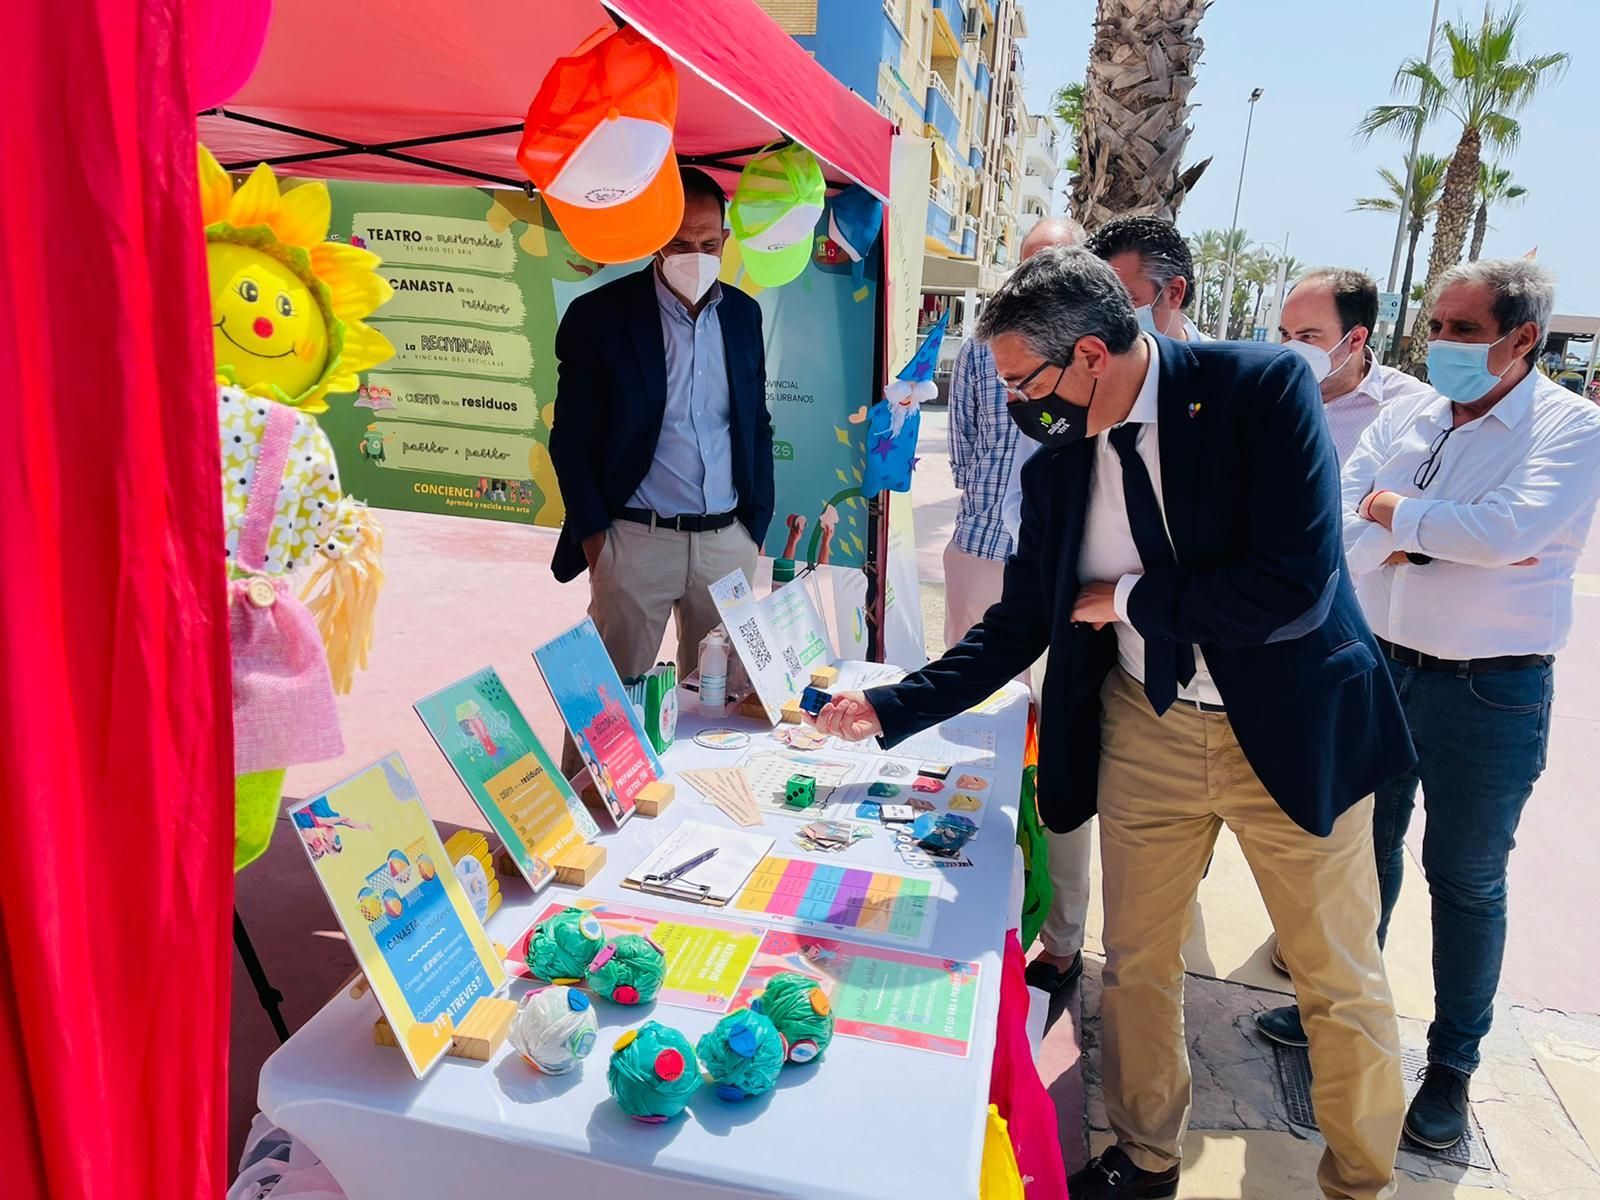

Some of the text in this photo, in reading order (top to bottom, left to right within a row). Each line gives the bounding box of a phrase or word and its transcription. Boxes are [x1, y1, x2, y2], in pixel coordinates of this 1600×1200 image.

[367, 228, 421, 242] TEATRO
[389, 278, 454, 294] CANASTA
[461, 298, 510, 314] residuos
[405, 335, 494, 356] La RECIYINCANA
[415, 355, 448, 363] YINCANA
[765, 380, 799, 390] OVINCIAL
[462, 396, 518, 412] residuos
[776, 394, 815, 403] URBANOS
[402, 441, 449, 455] pasito
[465, 447, 511, 461] pasito
[516, 506, 530, 514] arte
[520, 766, 543, 784] residuos
[387, 919, 420, 951] CANASTA
[446, 976, 482, 1018] ATREVES?
